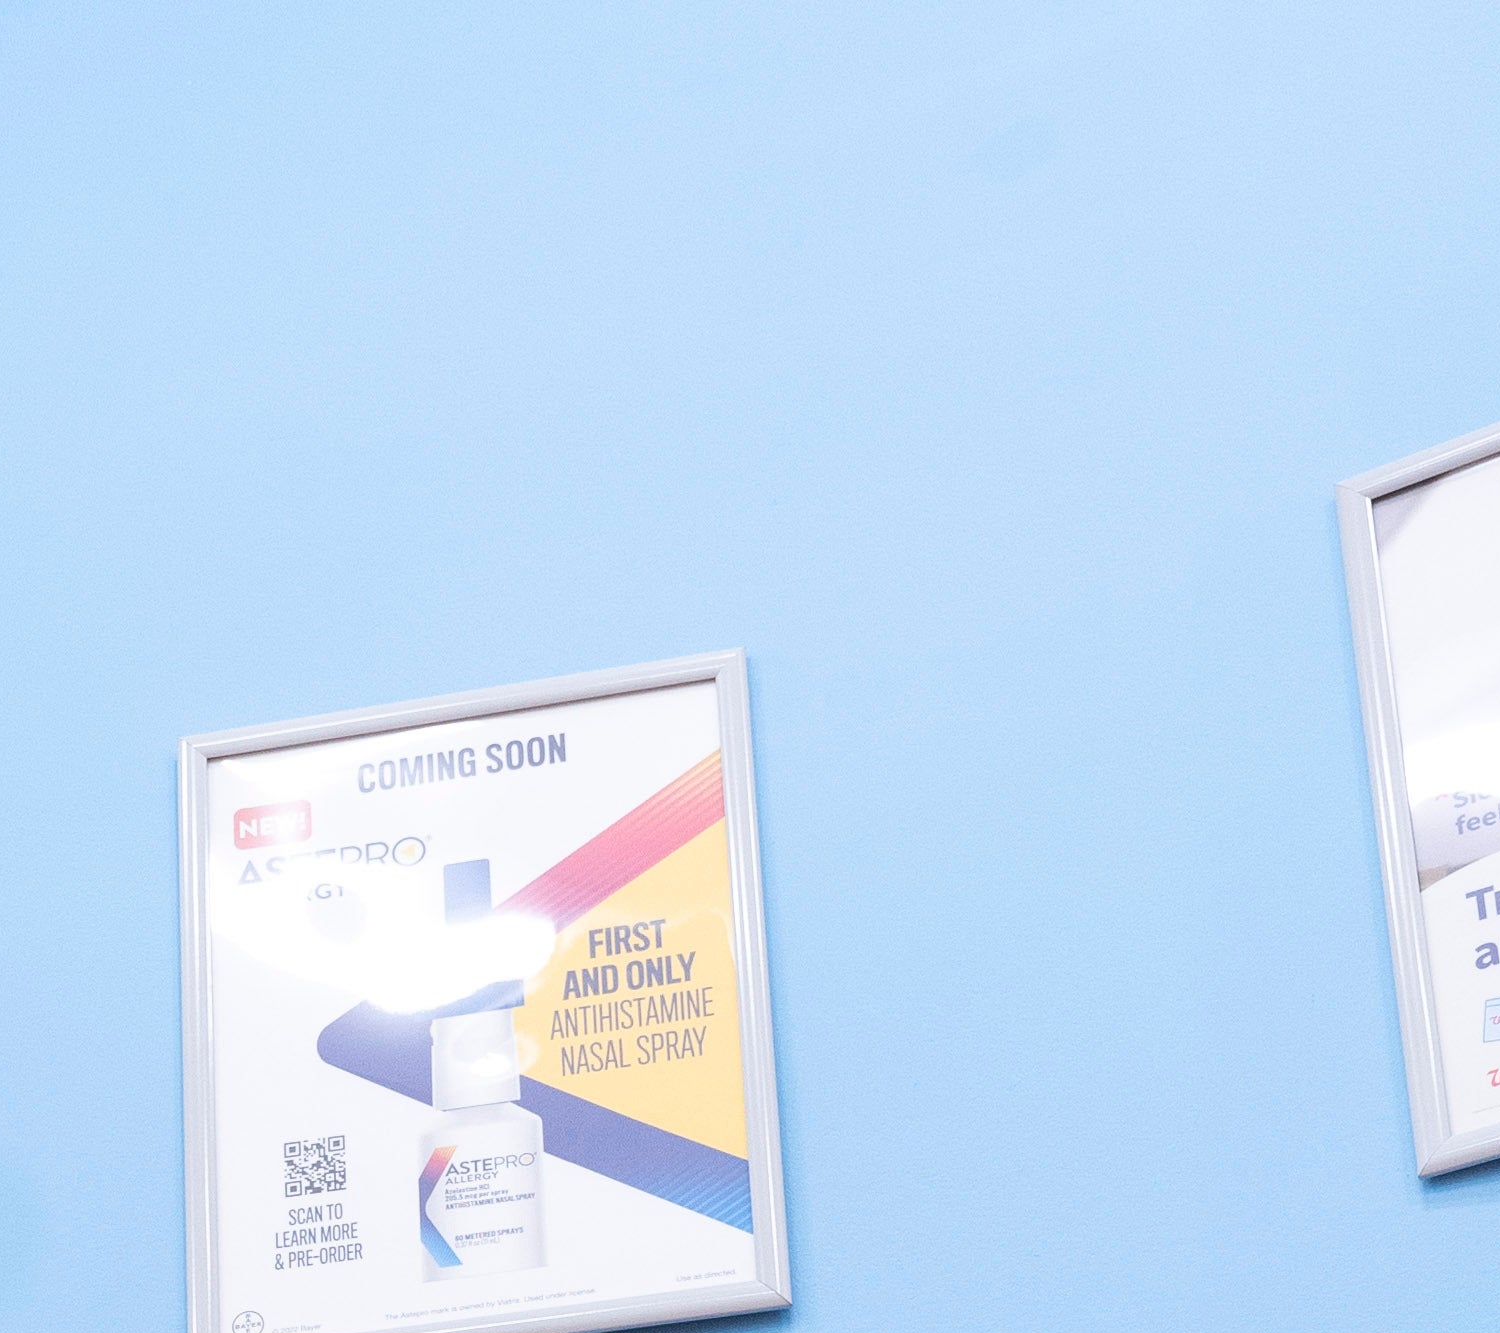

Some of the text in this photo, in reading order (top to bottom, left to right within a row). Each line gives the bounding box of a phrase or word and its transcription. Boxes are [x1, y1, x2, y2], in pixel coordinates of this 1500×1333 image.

[357, 733, 567, 794] COMING SOON
[588, 919, 667, 959] FIRST
[562, 951, 696, 1001] AND ONLY
[550, 987, 715, 1041] ANTIHISTAMINE
[561, 1025, 707, 1077] NASAL SPRAY
[445, 1171, 499, 1185] ALLERGY
[288, 1203, 343, 1225] SCAN TO
[275, 1222, 358, 1249] LEARN MORE
[275, 1243, 363, 1270] & PRE-ORDER
